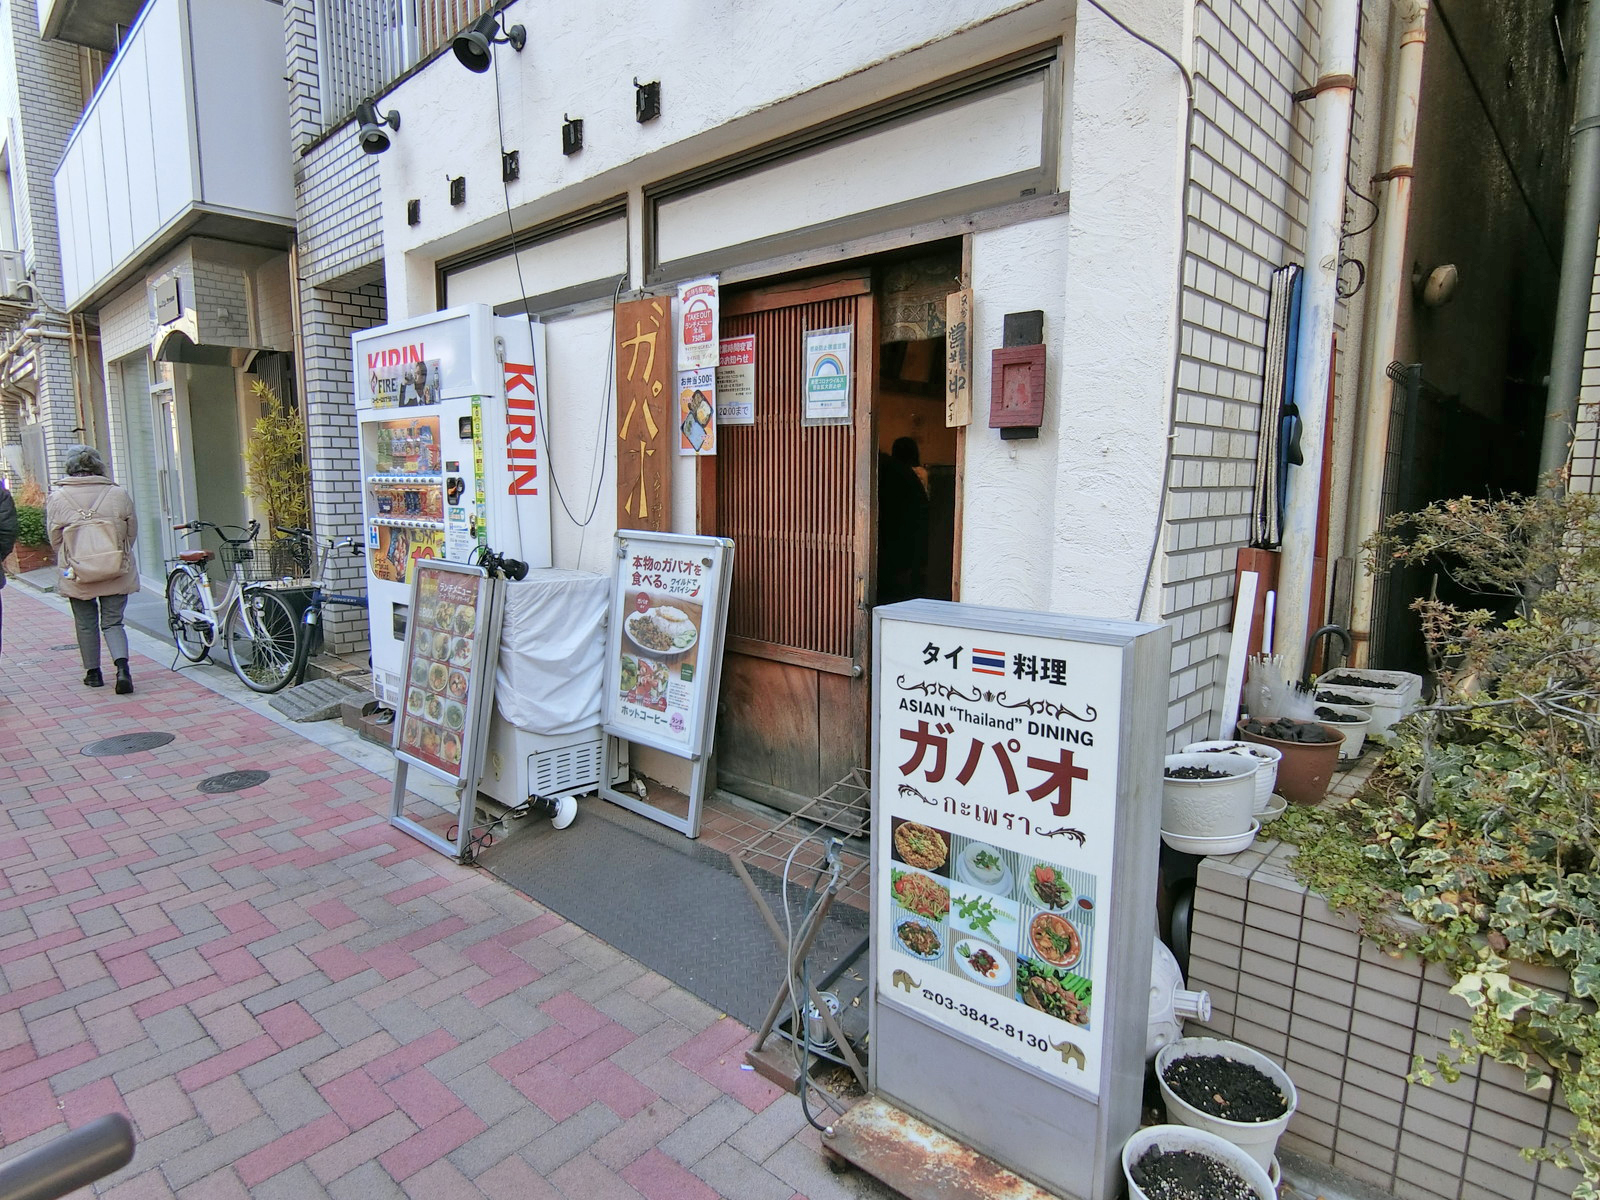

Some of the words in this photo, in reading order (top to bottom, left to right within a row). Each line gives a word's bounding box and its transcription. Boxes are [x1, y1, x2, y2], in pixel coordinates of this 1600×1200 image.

[378, 377, 398, 394] FIRE
[619, 301, 664, 519] ガパオ
[504, 362, 538, 496] KIRIN
[631, 571, 668, 590] 食べる。
[632, 555, 702, 577] 本物のガパオを
[440, 582, 472, 596] ランチメニュー
[669, 585, 697, 594] スパイシー
[671, 578, 698, 586] ワイルドで
[922, 642, 964, 670] タイ
[1012, 653, 1067, 686] 料理
[621, 705, 668, 725] ホットコーヒー
[899, 697, 946, 718] ASIAN
[1027, 721, 1094, 747] DINING
[898, 719, 1089, 817] ガパオ
[943, 796, 1031, 835] กะเพรา
[934, 993, 1049, 1053] 03-3842-8130
